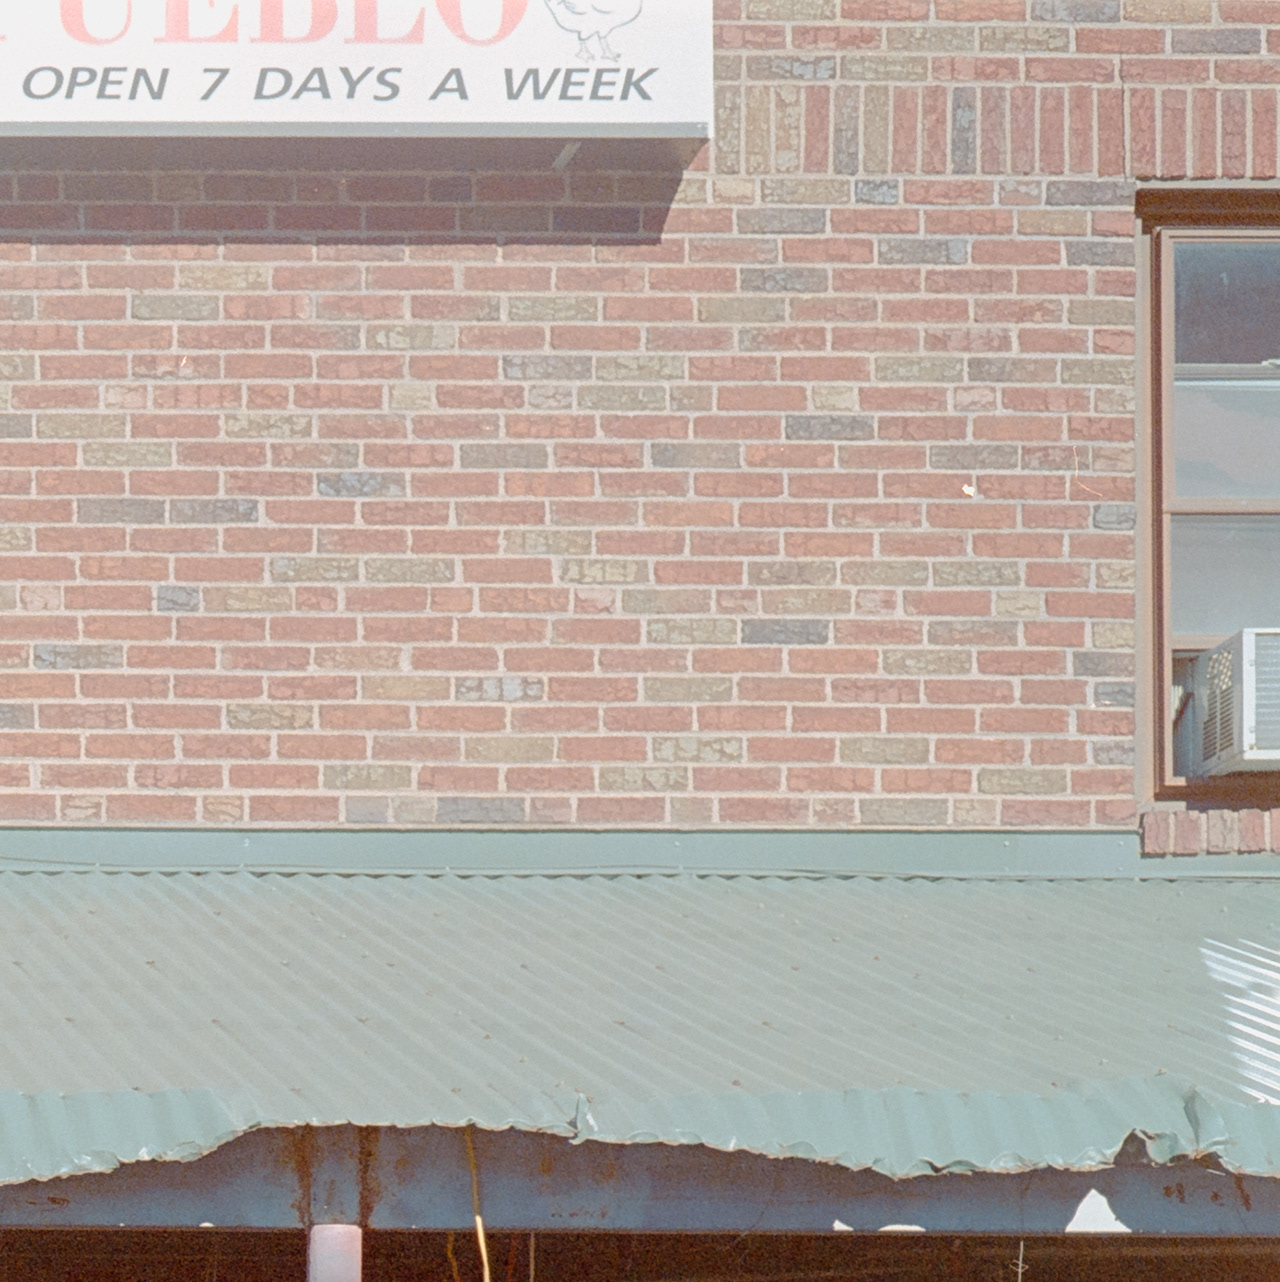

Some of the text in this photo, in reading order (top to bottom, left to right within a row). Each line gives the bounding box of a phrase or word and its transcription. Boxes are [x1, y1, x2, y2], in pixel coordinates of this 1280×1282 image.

[22, 66, 169, 100] OPEN
[200, 67, 230, 100] 7
[253, 67, 403, 101] DAYS
[429, 68, 469, 100] A
[503, 67, 659, 101] WEEK
